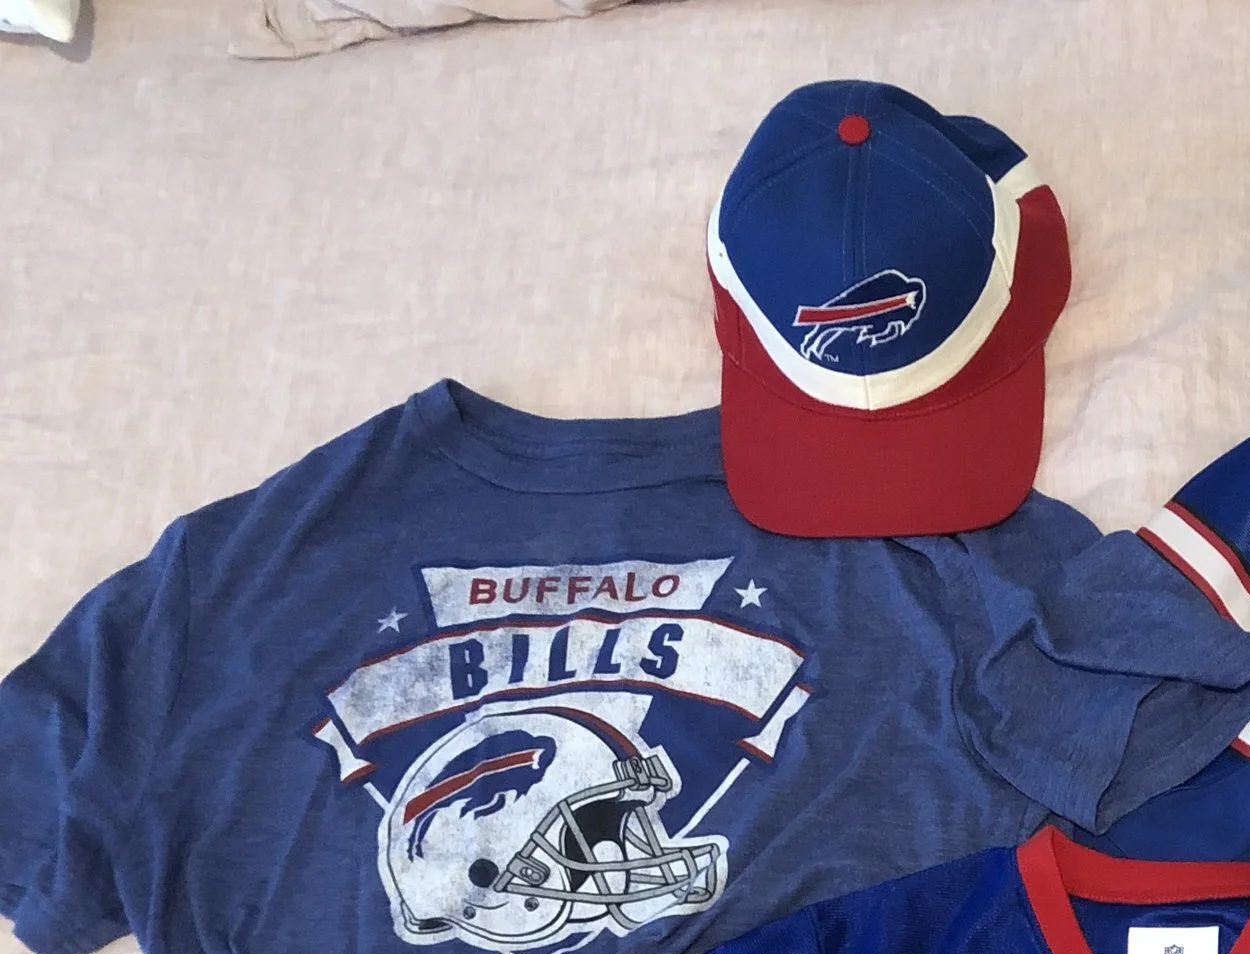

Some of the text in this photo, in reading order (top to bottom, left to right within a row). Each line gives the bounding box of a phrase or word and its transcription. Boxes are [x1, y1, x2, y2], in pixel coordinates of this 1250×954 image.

[824, 354, 839, 362] TM
[469, 572, 681, 605] BUFFALO
[448, 623, 683, 700] BILLS
